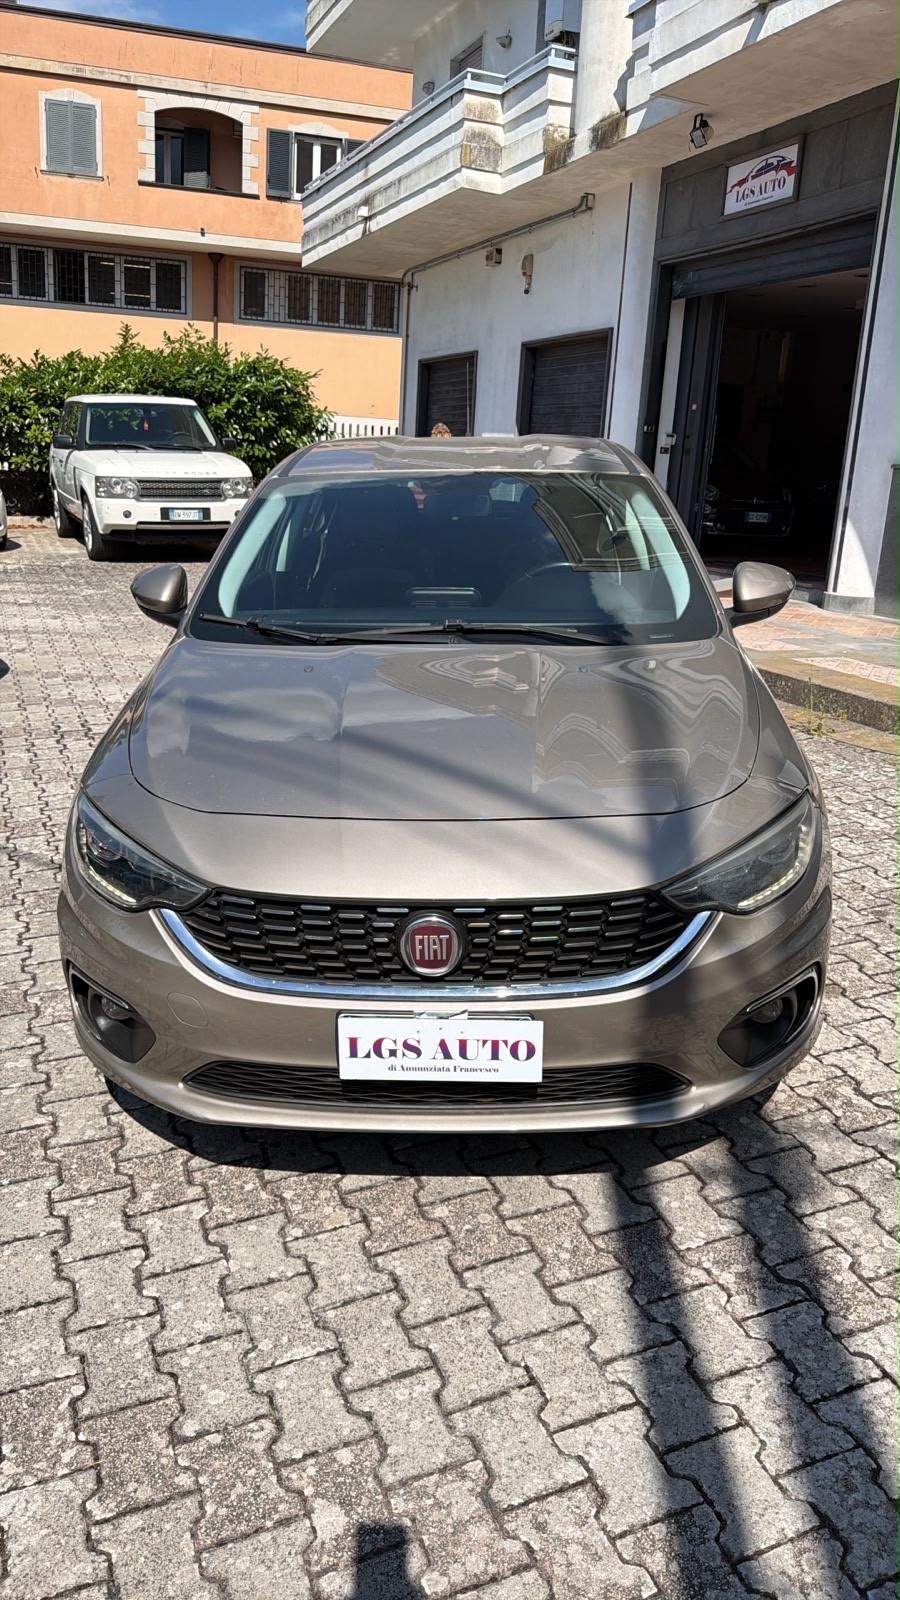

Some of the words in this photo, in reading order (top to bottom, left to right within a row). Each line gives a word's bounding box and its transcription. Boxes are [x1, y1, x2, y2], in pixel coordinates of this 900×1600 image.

[735, 185, 756, 203] LGS
[757, 176, 786, 196] AUTO
[414, 934, 450, 961] FIAT
[345, 1036, 423, 1060] LGS
[431, 1037, 537, 1062] AUTO
[387, 1064, 397, 1072] di
[399, 1064, 451, 1073] Annunziata
[453, 1065, 499, 1073] Francesco
